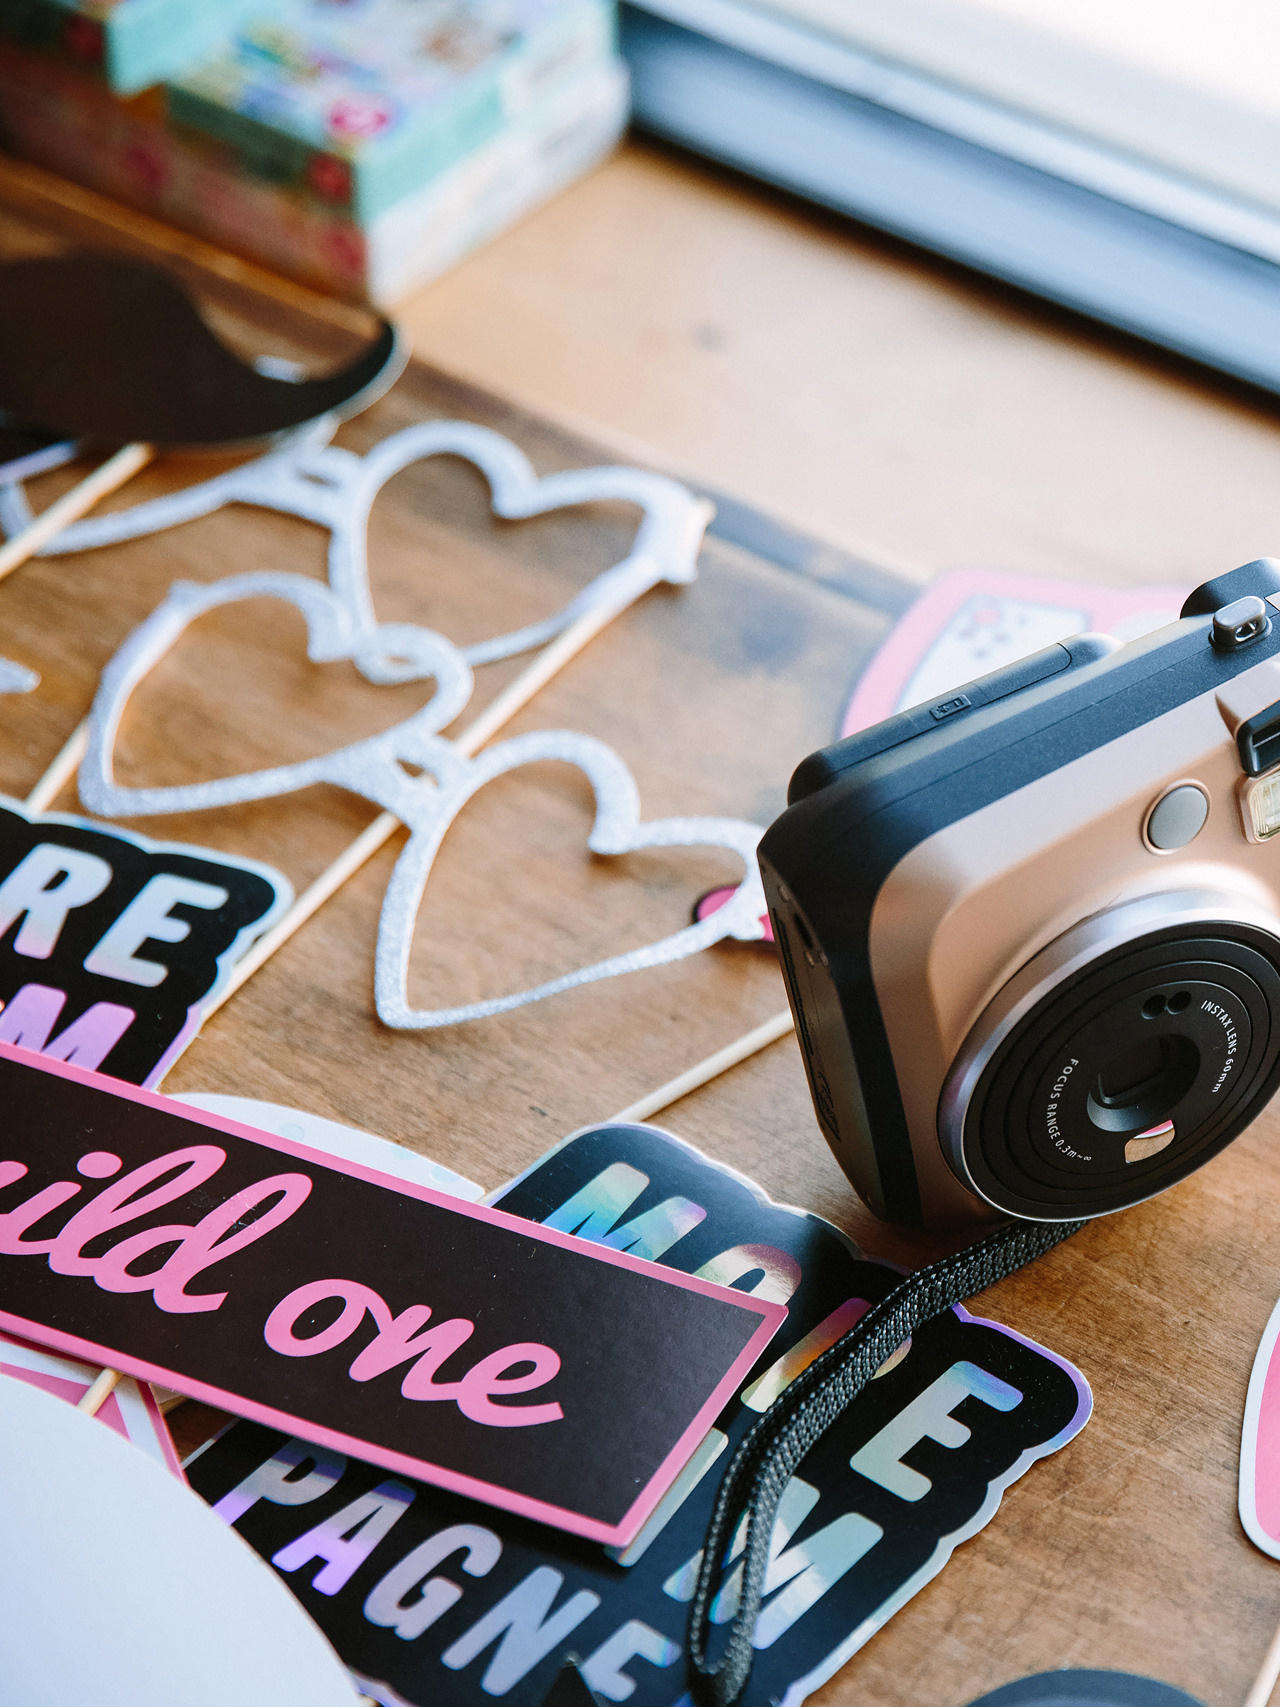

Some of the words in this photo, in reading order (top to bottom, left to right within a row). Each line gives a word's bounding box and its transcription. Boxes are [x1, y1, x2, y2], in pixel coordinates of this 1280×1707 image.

[1201, 1000, 1233, 1029] INSTAX
[1226, 1027, 1238, 1055] LENS
[1050, 1058, 1079, 1099] FOCUS
[1211, 1058, 1234, 1093] 60mm
[1046, 1103, 1061, 1140] RANGE
[264, 1279, 564, 1428] one
